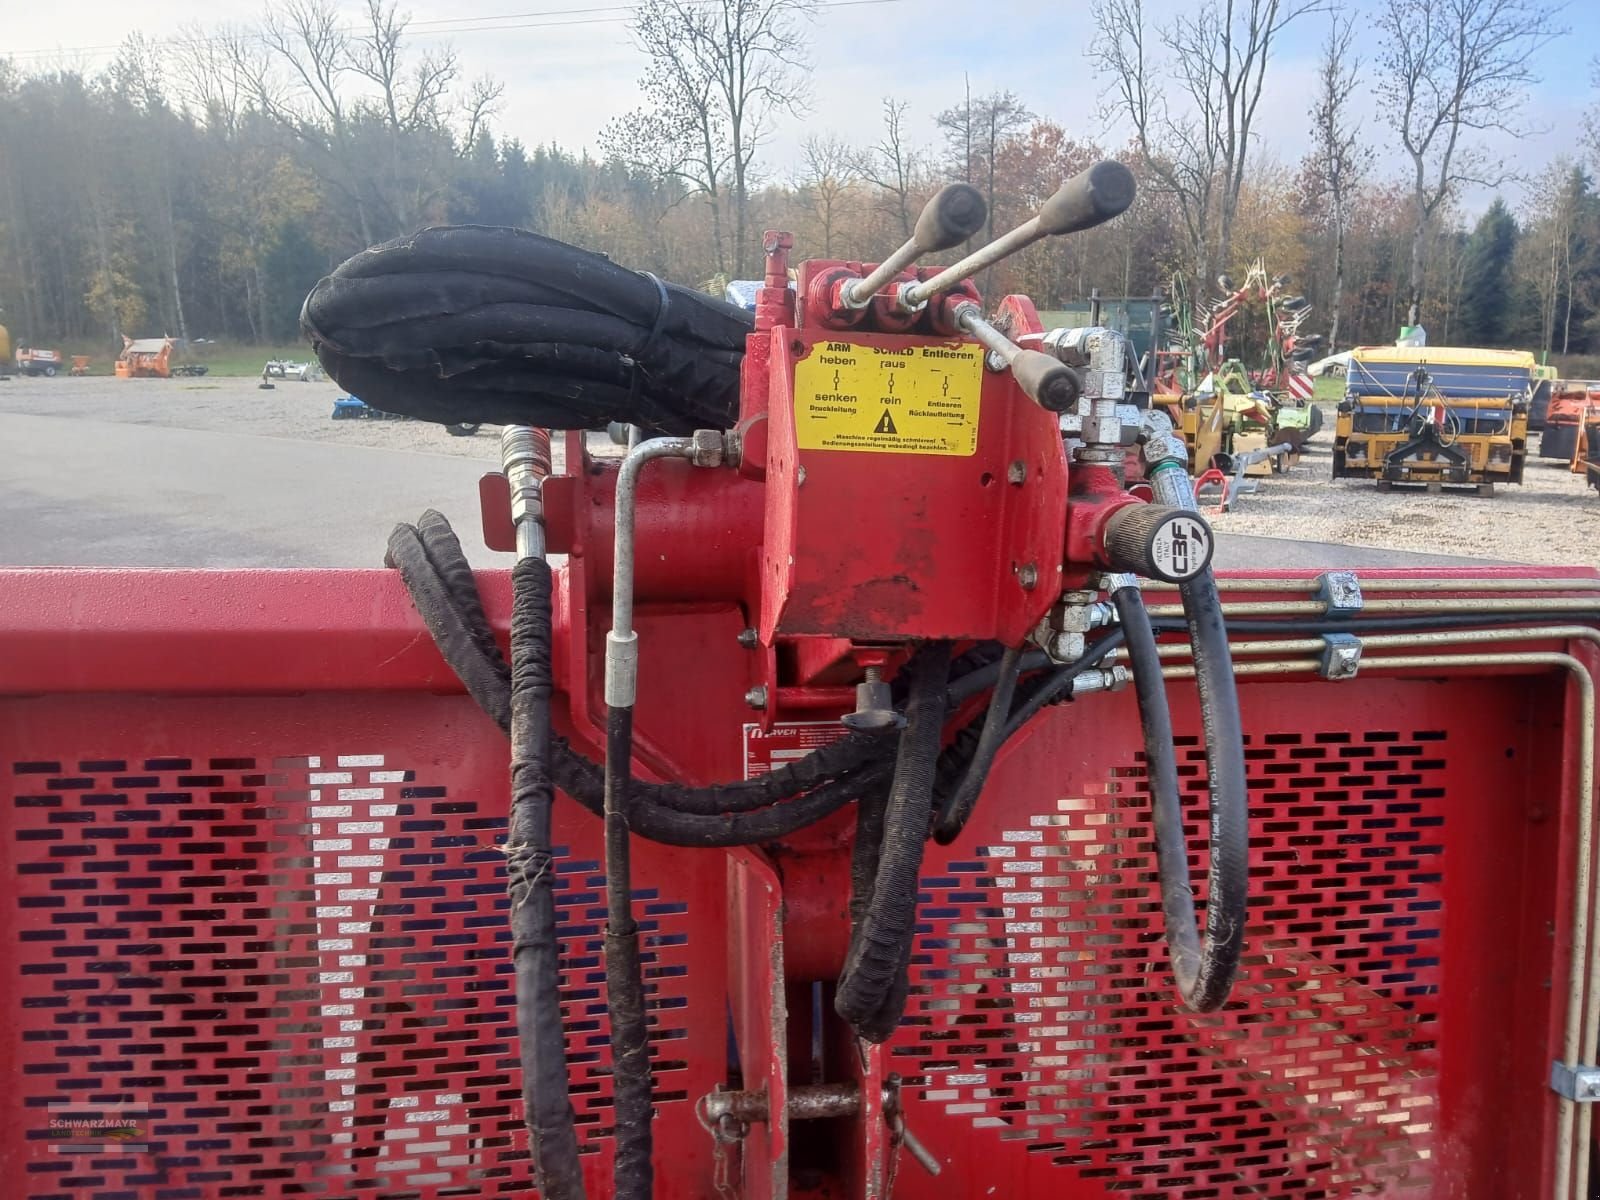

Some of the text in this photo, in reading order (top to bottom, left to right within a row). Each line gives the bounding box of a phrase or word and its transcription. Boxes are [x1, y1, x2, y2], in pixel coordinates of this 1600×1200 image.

[826, 343, 851, 352] ARM
[922, 349, 974, 360] Entleeren
[820, 355, 906, 369] heben raus
[815, 393, 901, 405] senken rein
[927, 400, 962, 409] Entleeren
[809, 404, 857, 414] Druckleitung
[908, 409, 965, 420] Rücklaufleitung
